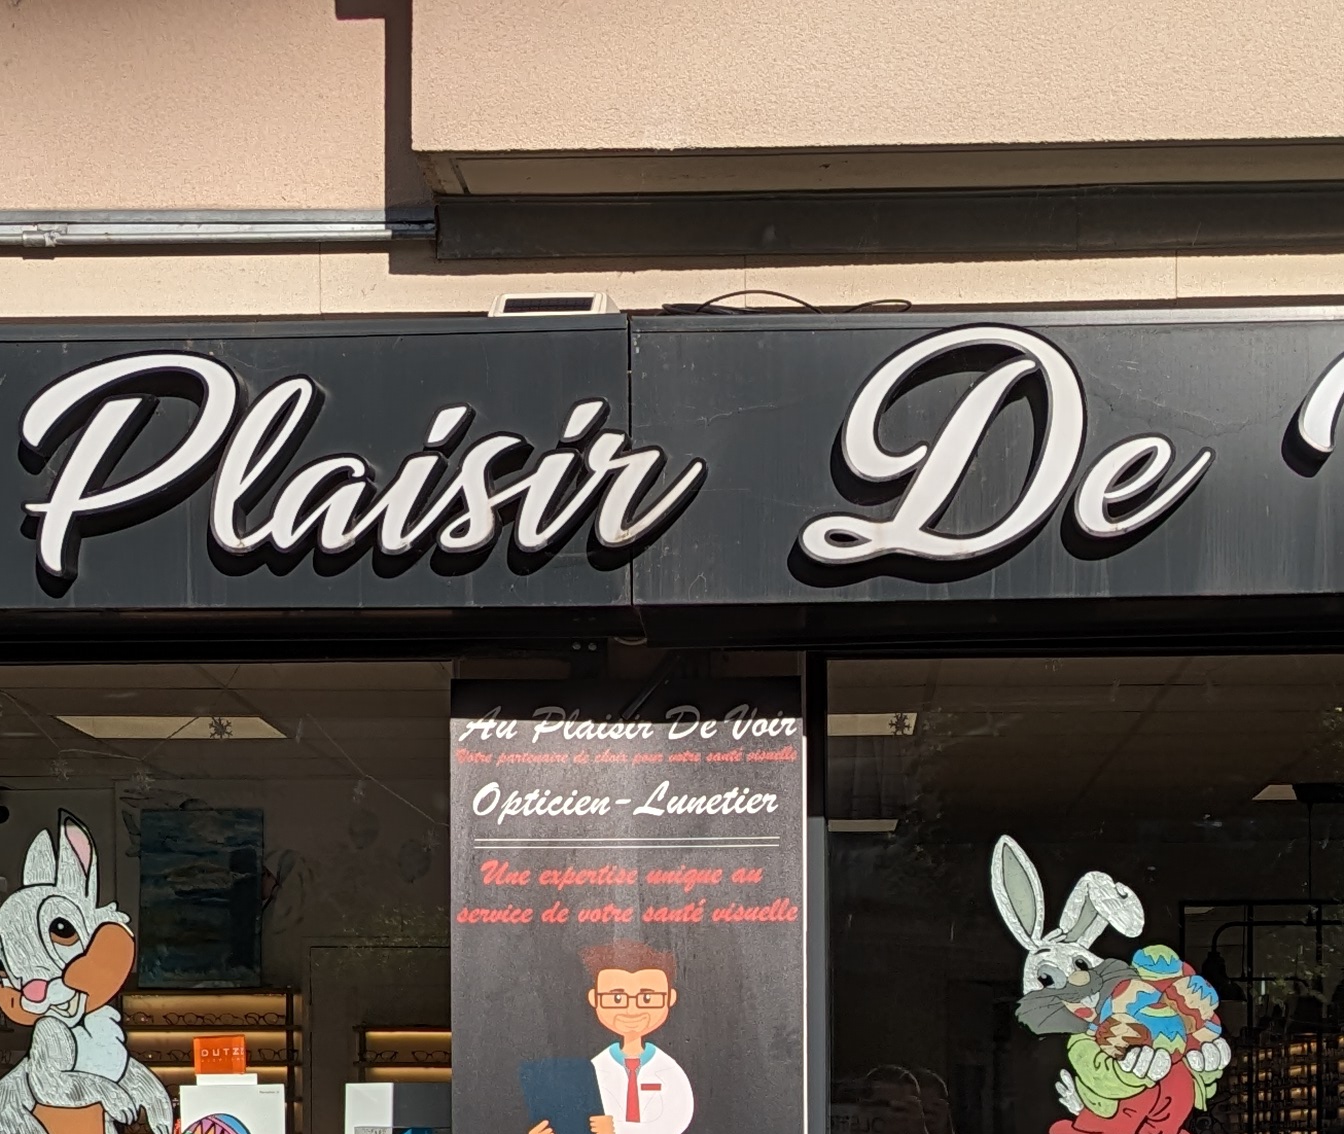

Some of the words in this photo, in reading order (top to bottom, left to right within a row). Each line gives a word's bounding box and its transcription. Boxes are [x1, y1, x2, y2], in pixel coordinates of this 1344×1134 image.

[20, 352, 706, 577] Plaisir
[798, 324, 1214, 563] De
[459, 705, 518, 743] Au
[532, 705, 654, 743] Plaisir
[665, 705, 717, 741] De
[723, 704, 798, 741] Voir
[472, 780, 779, 825] Opticien-Lunetier
[479, 860, 531, 886] Une
[539, 865, 639, 891] expertise
[646, 865, 724, 893] unique
[731, 866, 764, 885] au
[457, 905, 534, 924] service
[541, 901, 570, 924] de
[578, 903, 634, 924] votre
[643, 898, 707, 924] santé
[712, 898, 799, 923] visuelle
